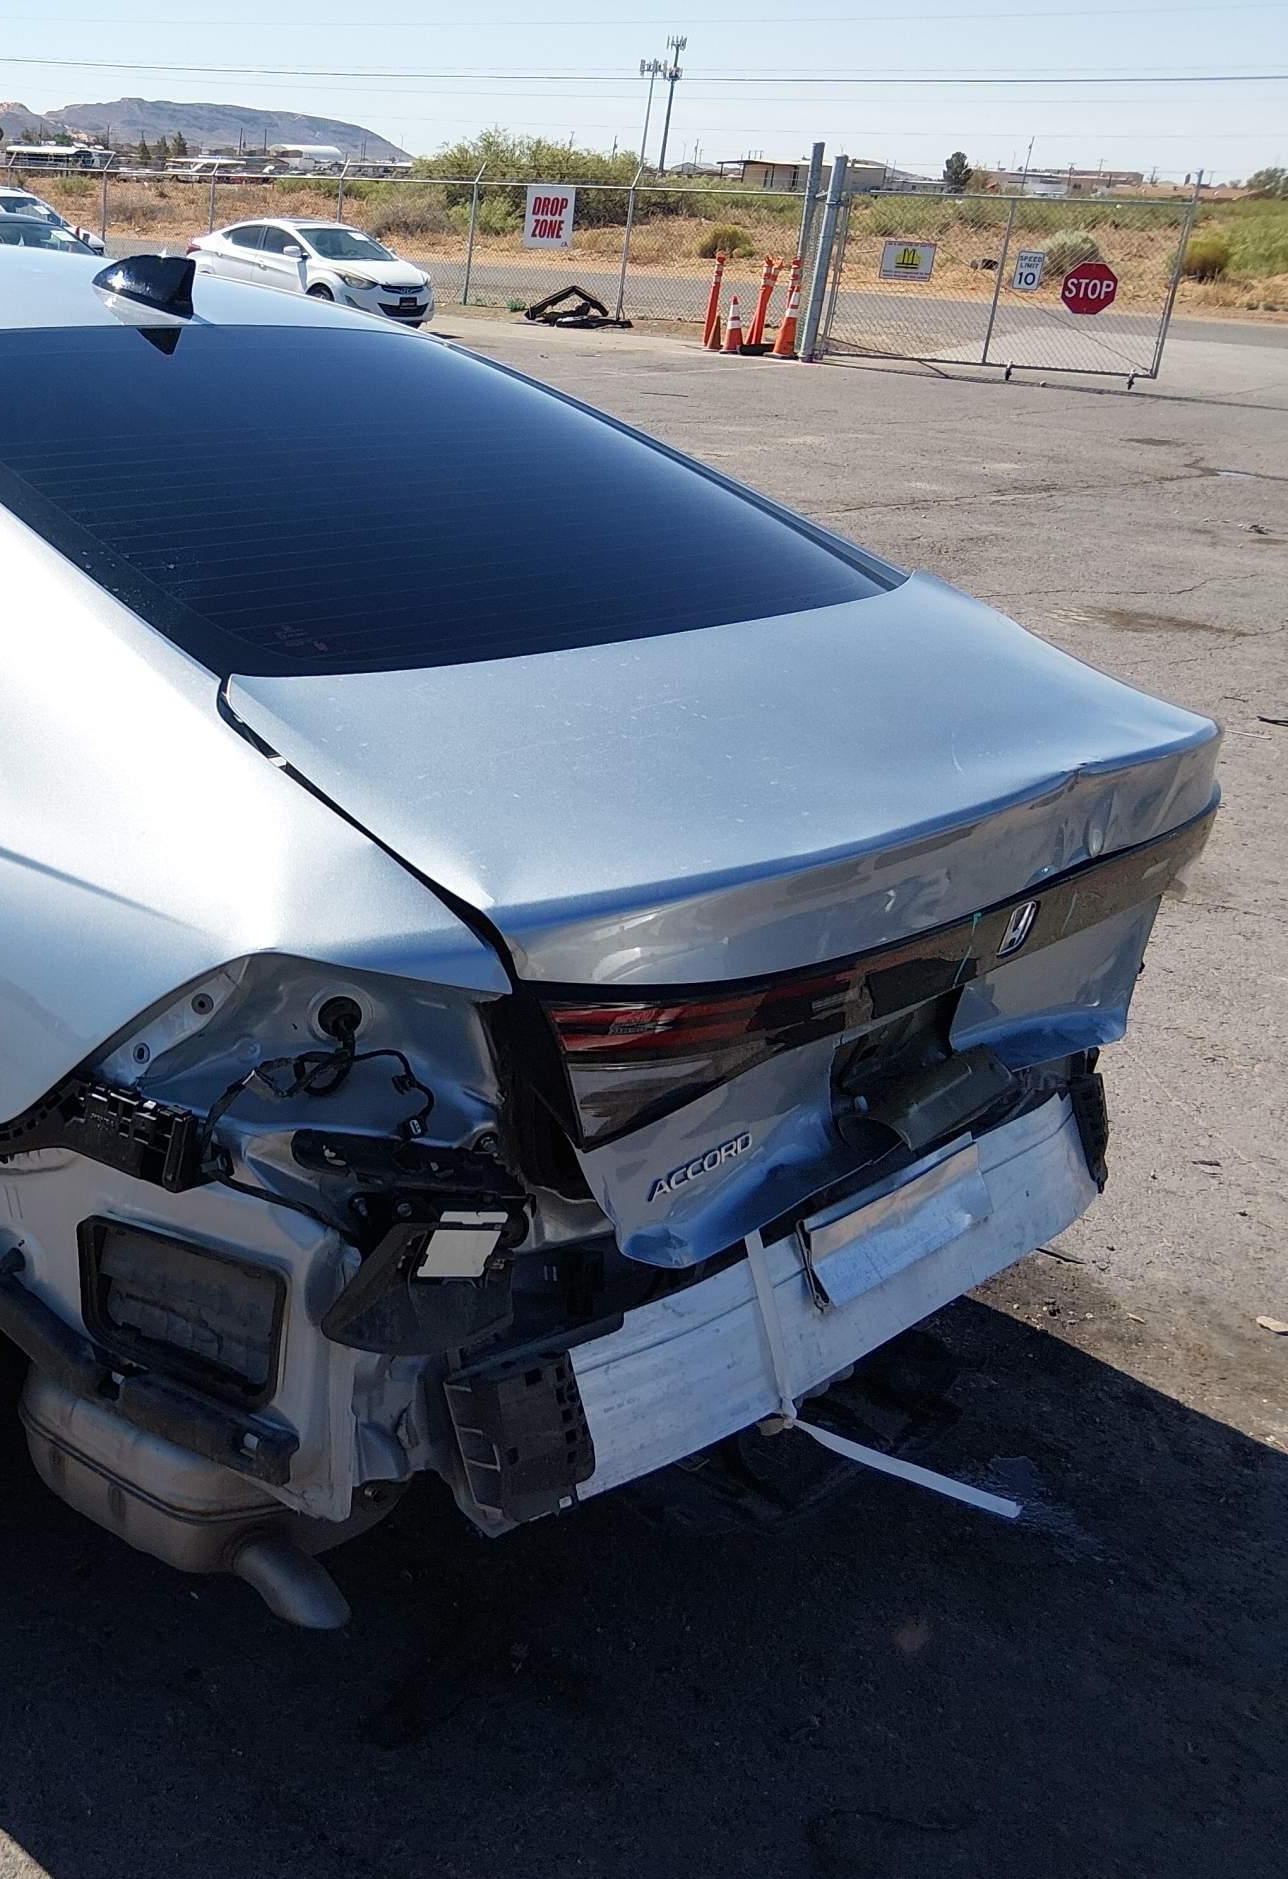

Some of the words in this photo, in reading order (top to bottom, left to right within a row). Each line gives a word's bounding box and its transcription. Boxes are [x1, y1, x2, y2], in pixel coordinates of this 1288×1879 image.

[532, 196, 569, 217] DROP
[530, 218, 565, 239] ZONE
[1020, 255, 1043, 263] SPEED
[1020, 262, 1040, 270] LIMIT
[1018, 272, 1036, 286] 10
[1064, 278, 1115, 300] STOP
[647, 1131, 753, 1203] ACCORD
